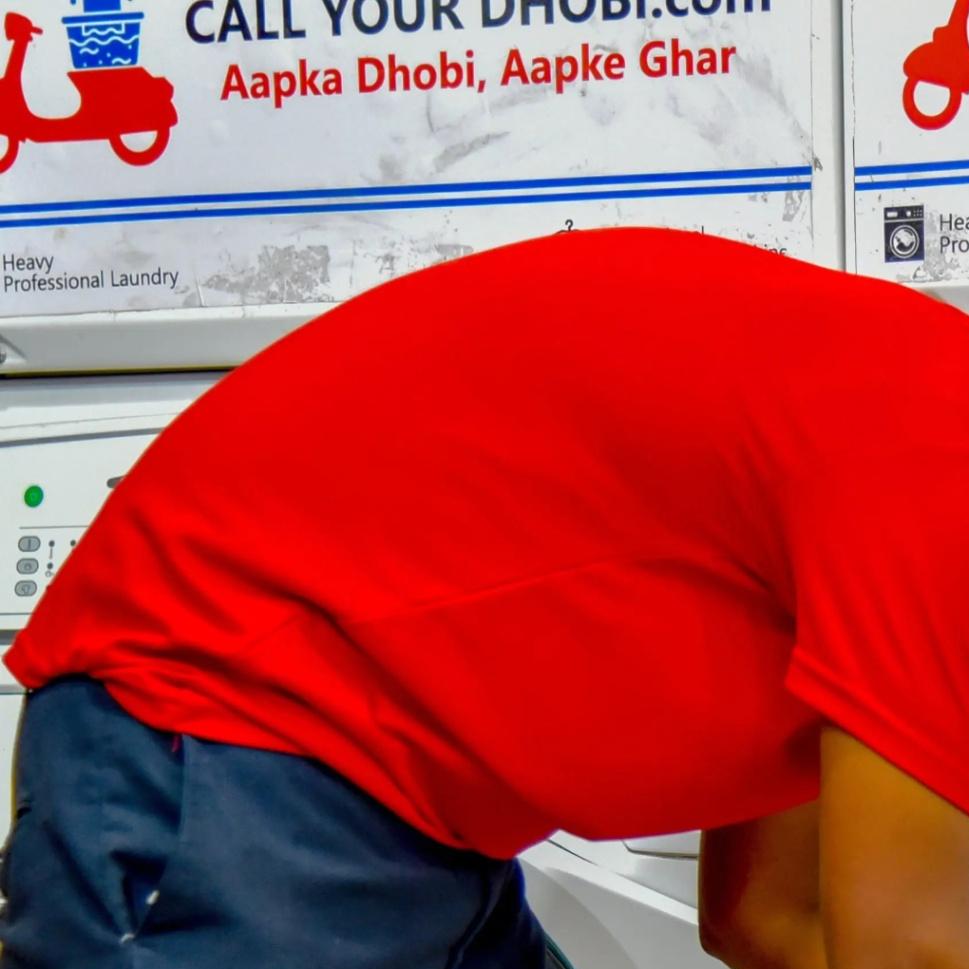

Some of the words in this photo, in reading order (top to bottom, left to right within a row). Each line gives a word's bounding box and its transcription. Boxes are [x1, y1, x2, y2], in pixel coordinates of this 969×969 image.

[185, 0, 307, 44] CALL
[322, 0, 464, 36] YOUR
[220, 58, 343, 109] Aapka
[357, 49, 486, 94] Dhobi,
[500, 43, 626, 94] Aapke
[639, 38, 737, 79] Ghar
[2, 254, 54, 274] Heavy
[3, 270, 105, 293] Professional
[110, 267, 179, 289] Laundry
